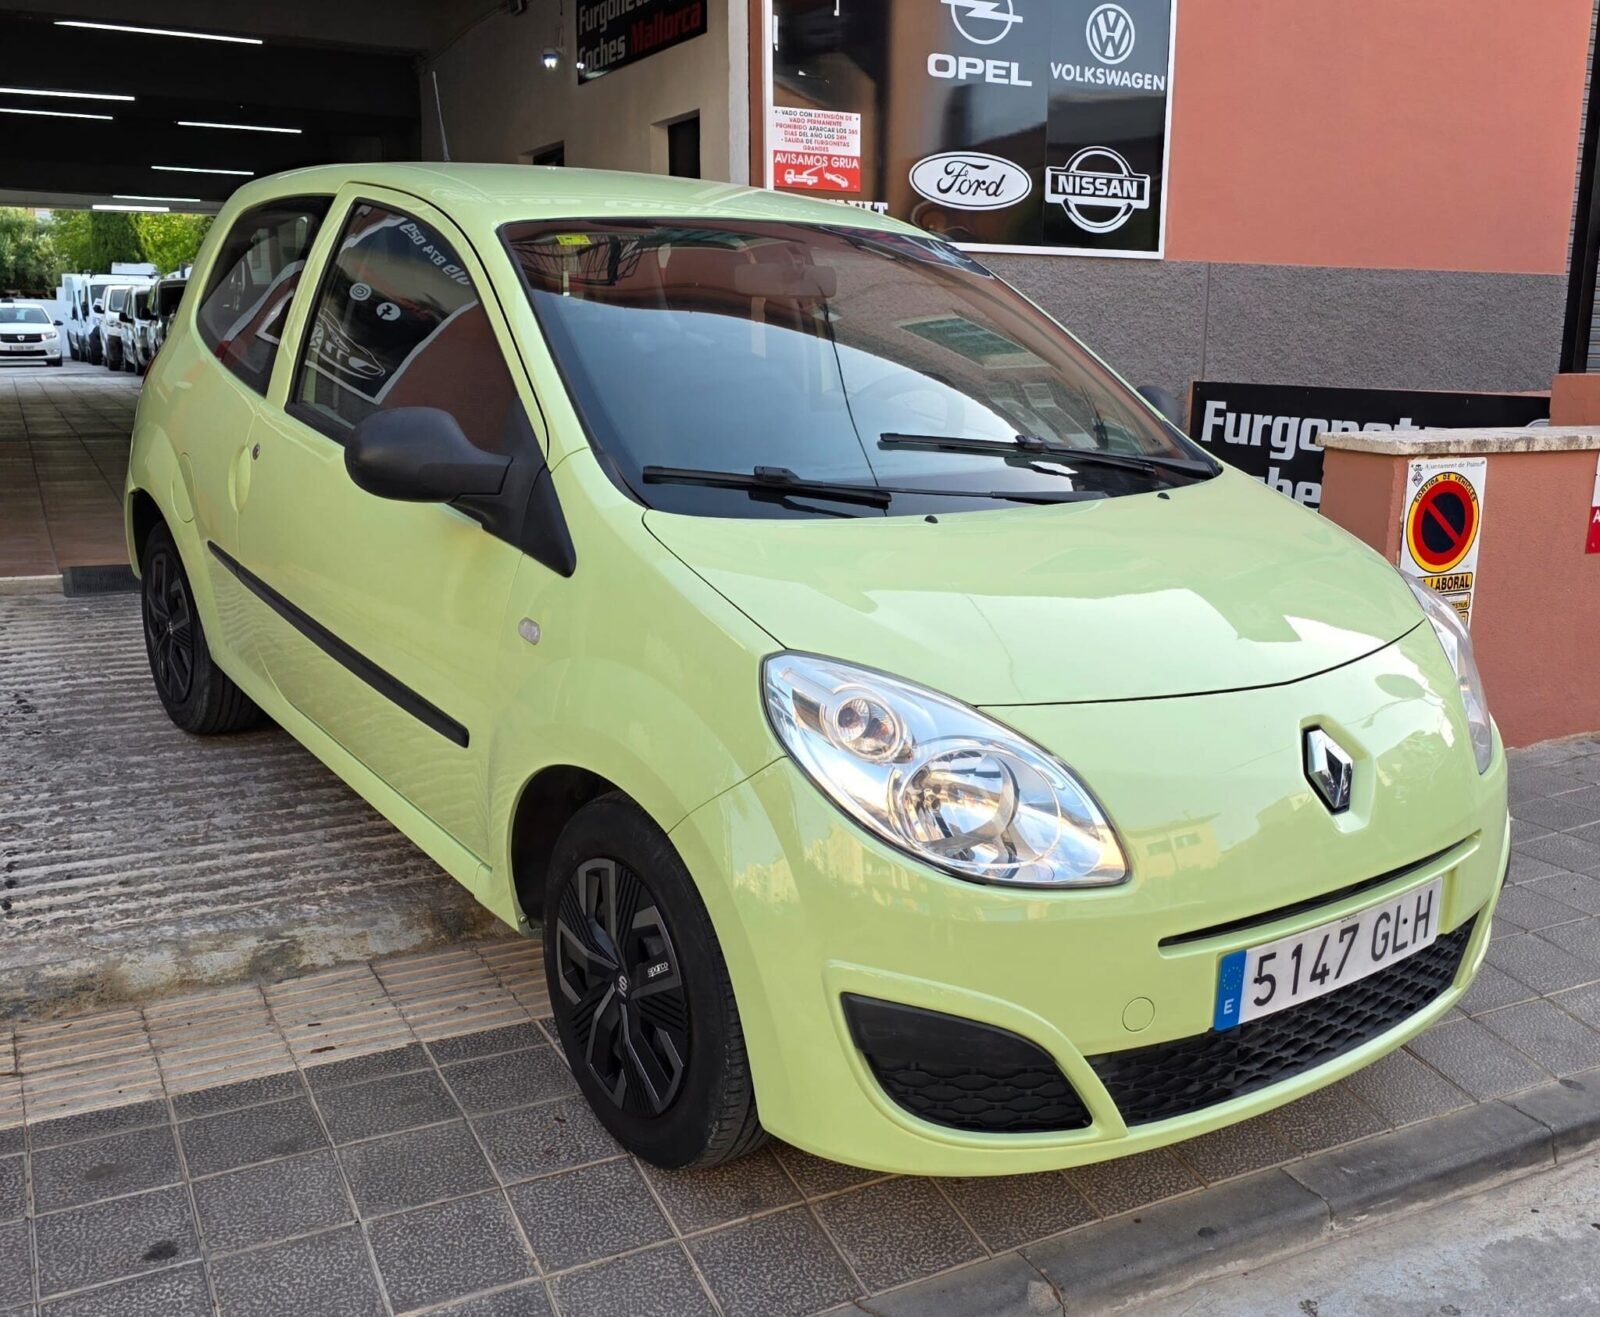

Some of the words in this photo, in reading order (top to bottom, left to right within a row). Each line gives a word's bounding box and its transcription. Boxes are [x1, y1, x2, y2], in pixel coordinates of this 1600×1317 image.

[630, 3, 700, 54] Mallorca
[926, 53, 1032, 87] OPEL
[1050, 62, 1165, 91] VOLKSWAGEN
[775, 122, 807, 131] PROHIBIDO
[807, 119, 842, 127] PERMANENTE
[814, 139, 850, 148] FURGONETAS
[774, 152, 828, 167] AVISAMOS
[831, 156, 859, 169] GRUA
[937, 161, 1006, 197] Ford
[1057, 175, 1138, 198] NISSAN
[1201, 400, 1438, 460] Furgo
[1414, 478, 1439, 502] SORTIDA
[1454, 475, 1476, 502] VEHICLES
[1223, 998, 1234, 1014] E
[1253, 923, 1360, 1006] 5147
[1371, 890, 1433, 962] GLH
